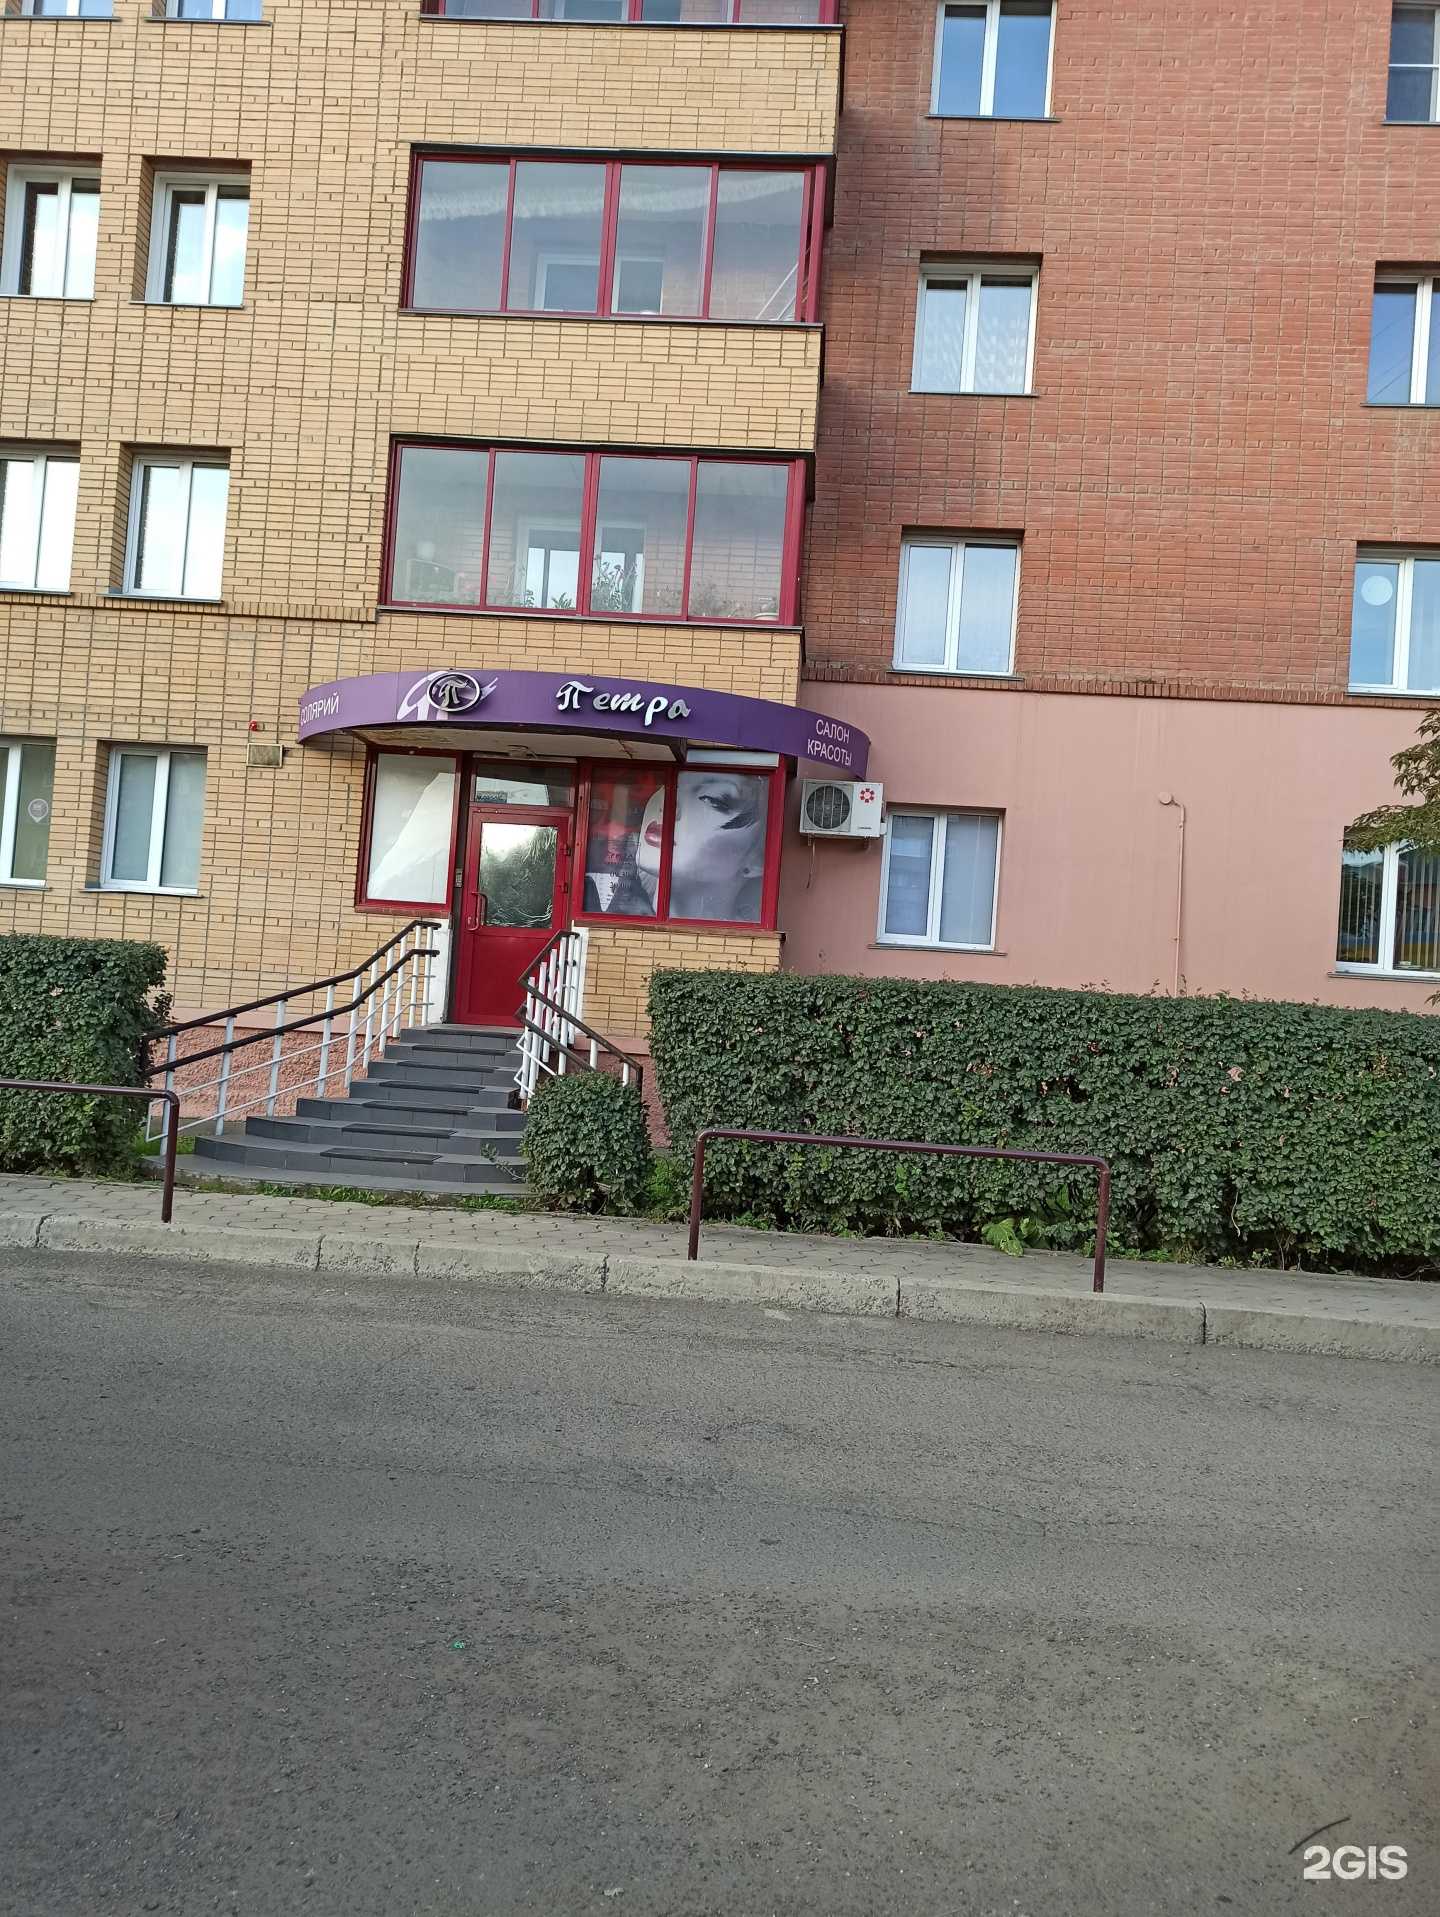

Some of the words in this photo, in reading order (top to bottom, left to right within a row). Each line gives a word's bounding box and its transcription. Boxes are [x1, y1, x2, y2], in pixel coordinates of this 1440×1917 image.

[556, 680, 692, 726] Петра
[815, 719, 850, 744] САЛОН
[807, 738, 852, 766] КРАСОТЫ
